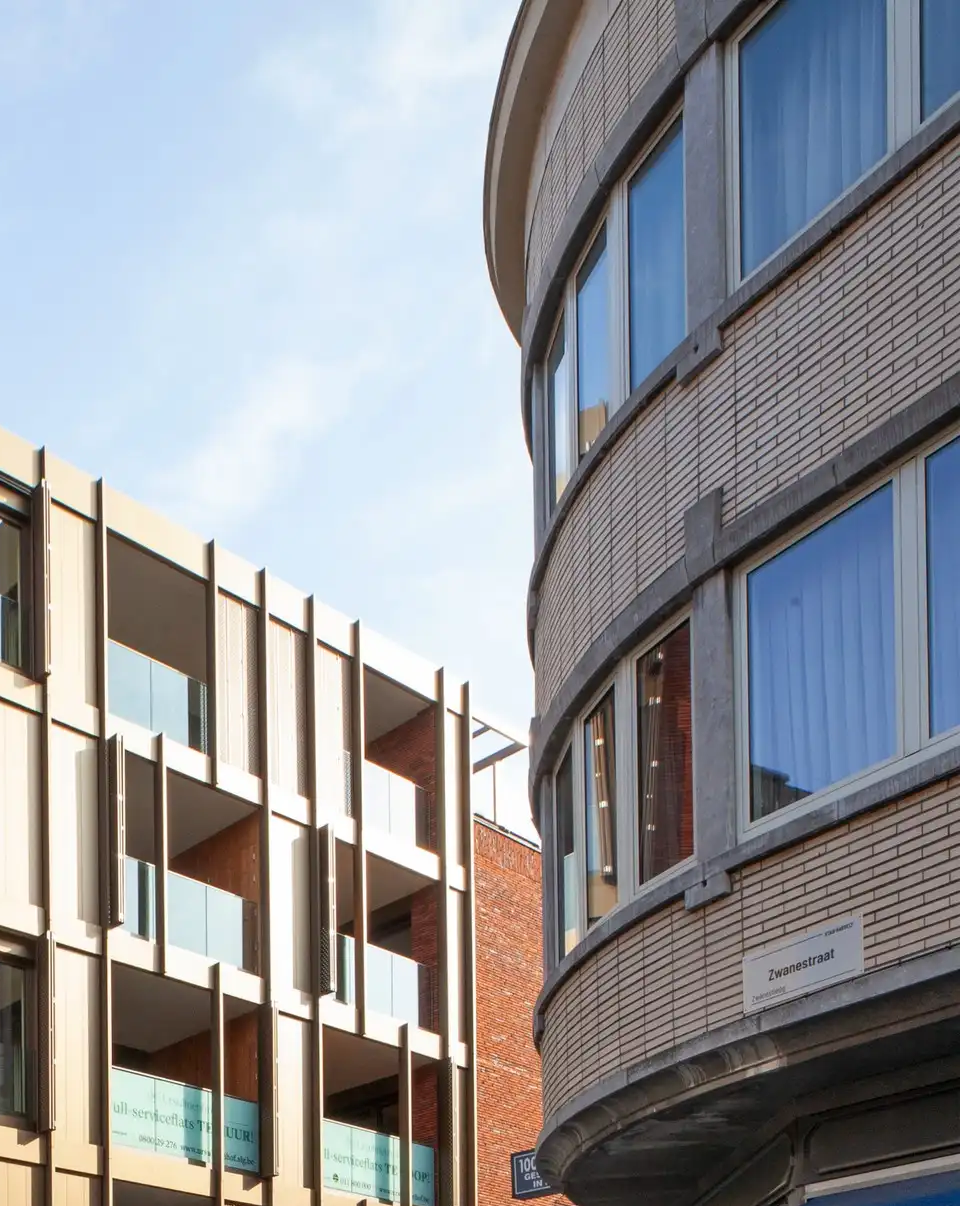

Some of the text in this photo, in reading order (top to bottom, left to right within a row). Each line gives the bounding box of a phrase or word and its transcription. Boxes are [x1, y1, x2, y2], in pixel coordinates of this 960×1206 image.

[768, 948, 835, 981] Zwanestraat
[113, 1101, 194, 1131] ull-serviceflats
[224, 1126, 254, 1143] UUR!
